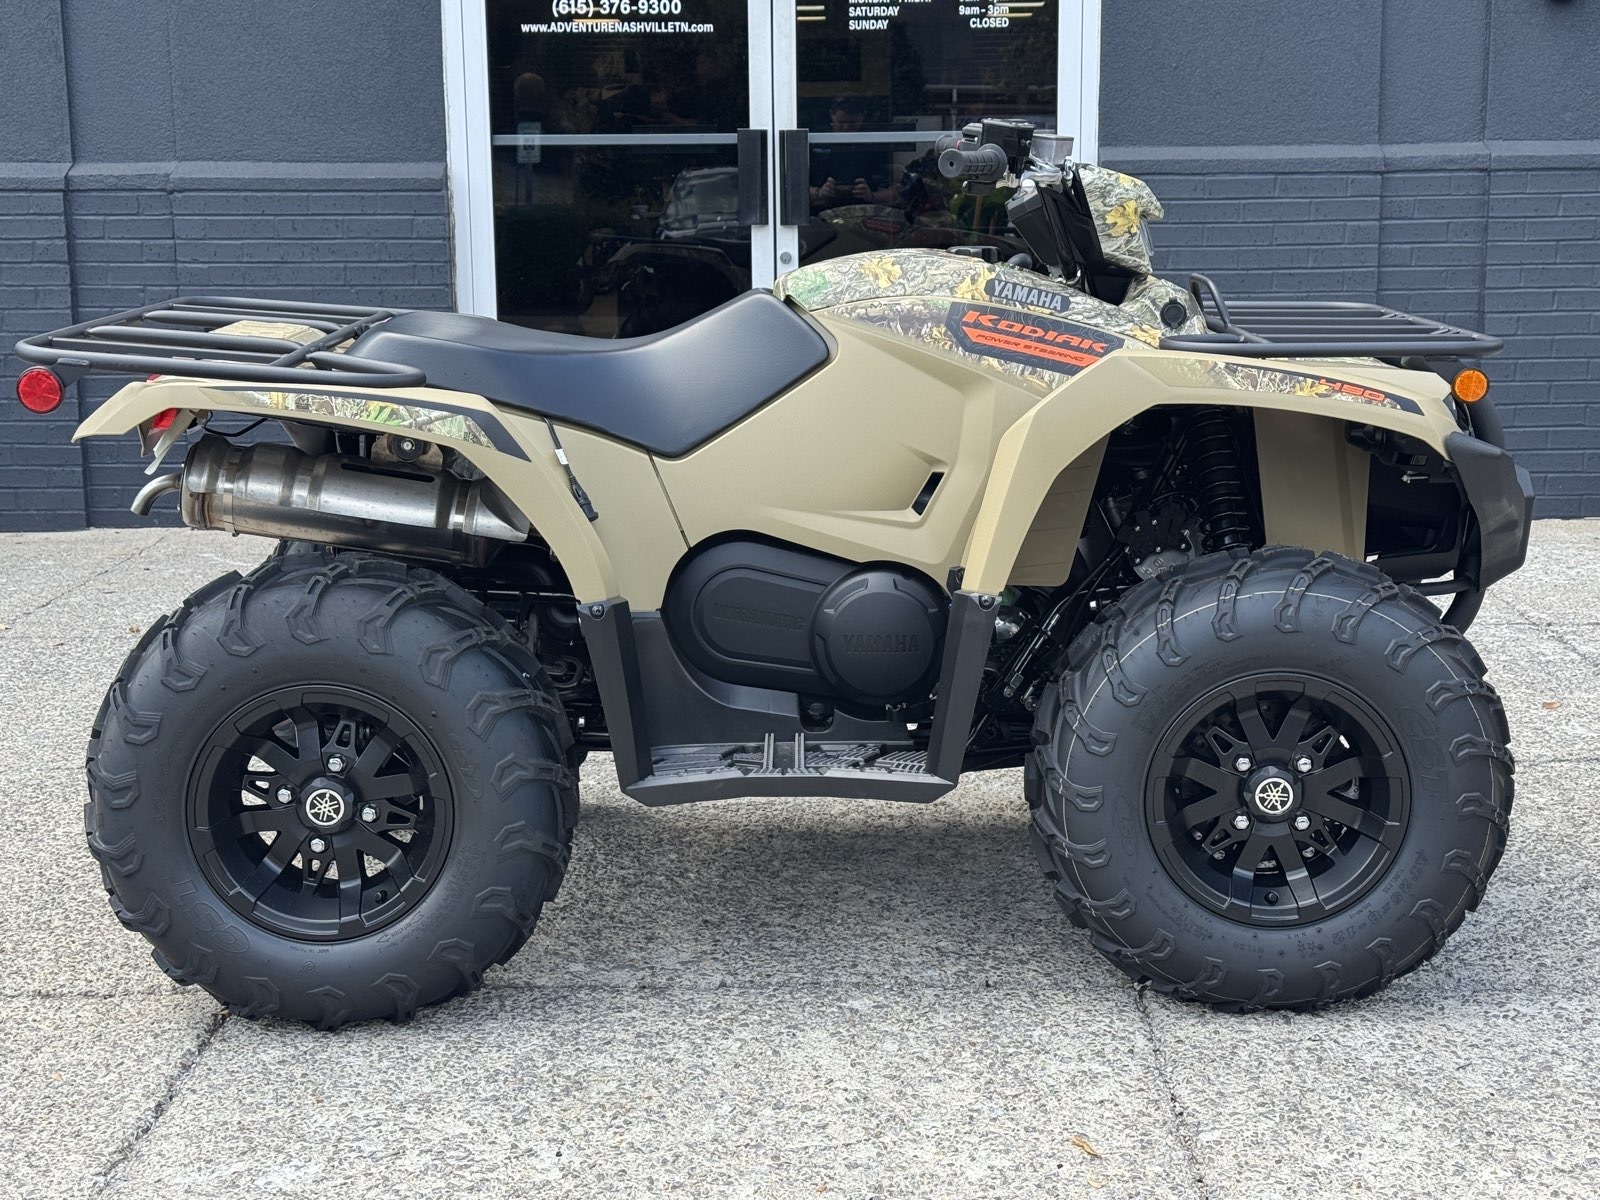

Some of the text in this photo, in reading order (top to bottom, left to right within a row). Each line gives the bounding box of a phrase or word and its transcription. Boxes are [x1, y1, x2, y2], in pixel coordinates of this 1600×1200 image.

[552, 0, 682, 17] (615) 376-9300
[848, 6, 900, 16] SATURDAY
[958, 5, 980, 15] 9am
[987, 5, 1009, 16] 3pm
[520, 22, 714, 33] www.ADVENTURENASHVILLETN.com
[848, 18, 1009, 30] SUNDAY CLOSED
[993, 280, 1062, 311] YAMAHA
[962, 310, 1110, 353] KODIAK
[976, 334, 1085, 362] POWER STEERING
[1319, 378, 1385, 401] 450
[842, 632, 920, 655] YAMAHA
[1399, 705, 1450, 802] CST
[160, 875, 251, 954] CST
